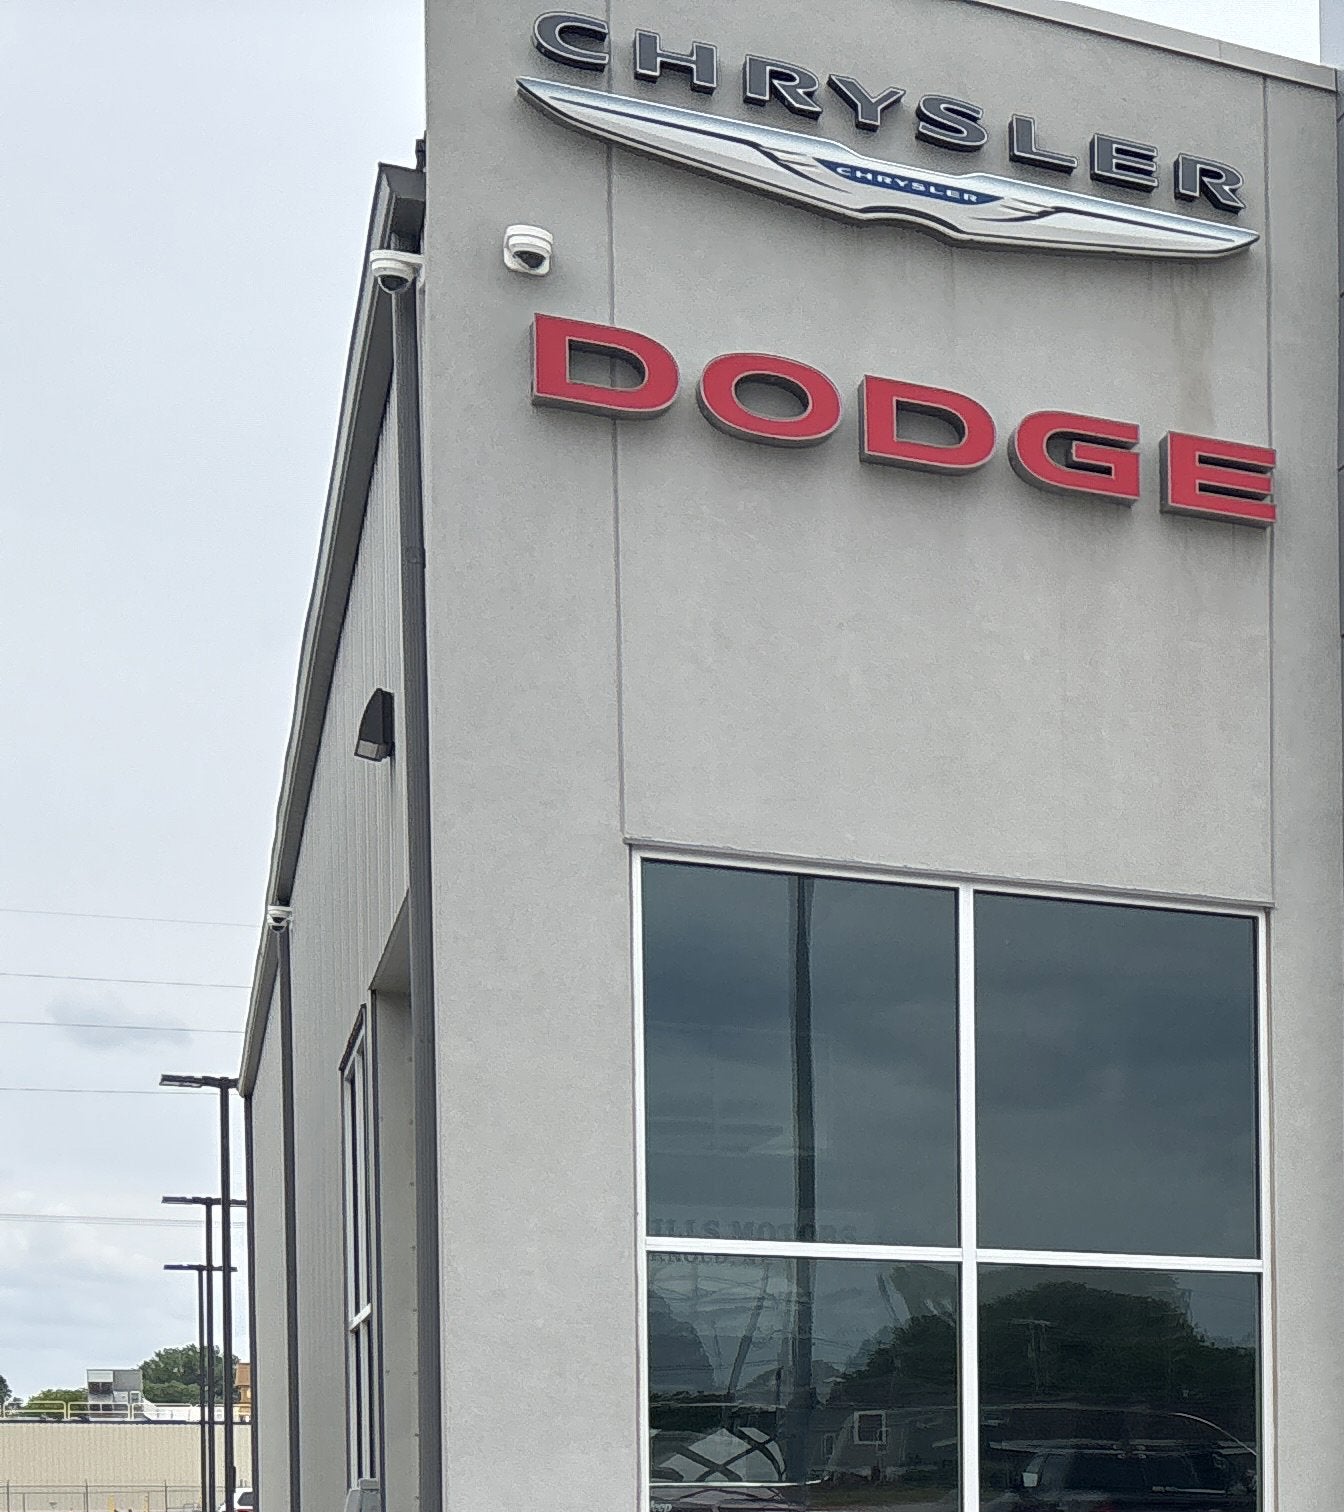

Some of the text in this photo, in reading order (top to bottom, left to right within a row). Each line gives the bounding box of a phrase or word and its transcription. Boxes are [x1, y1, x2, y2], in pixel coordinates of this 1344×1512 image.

[531, 10, 1247, 214] CHRYSLER
[836, 166, 978, 203] CHRYSLER
[529, 312, 1278, 528] DODGE
